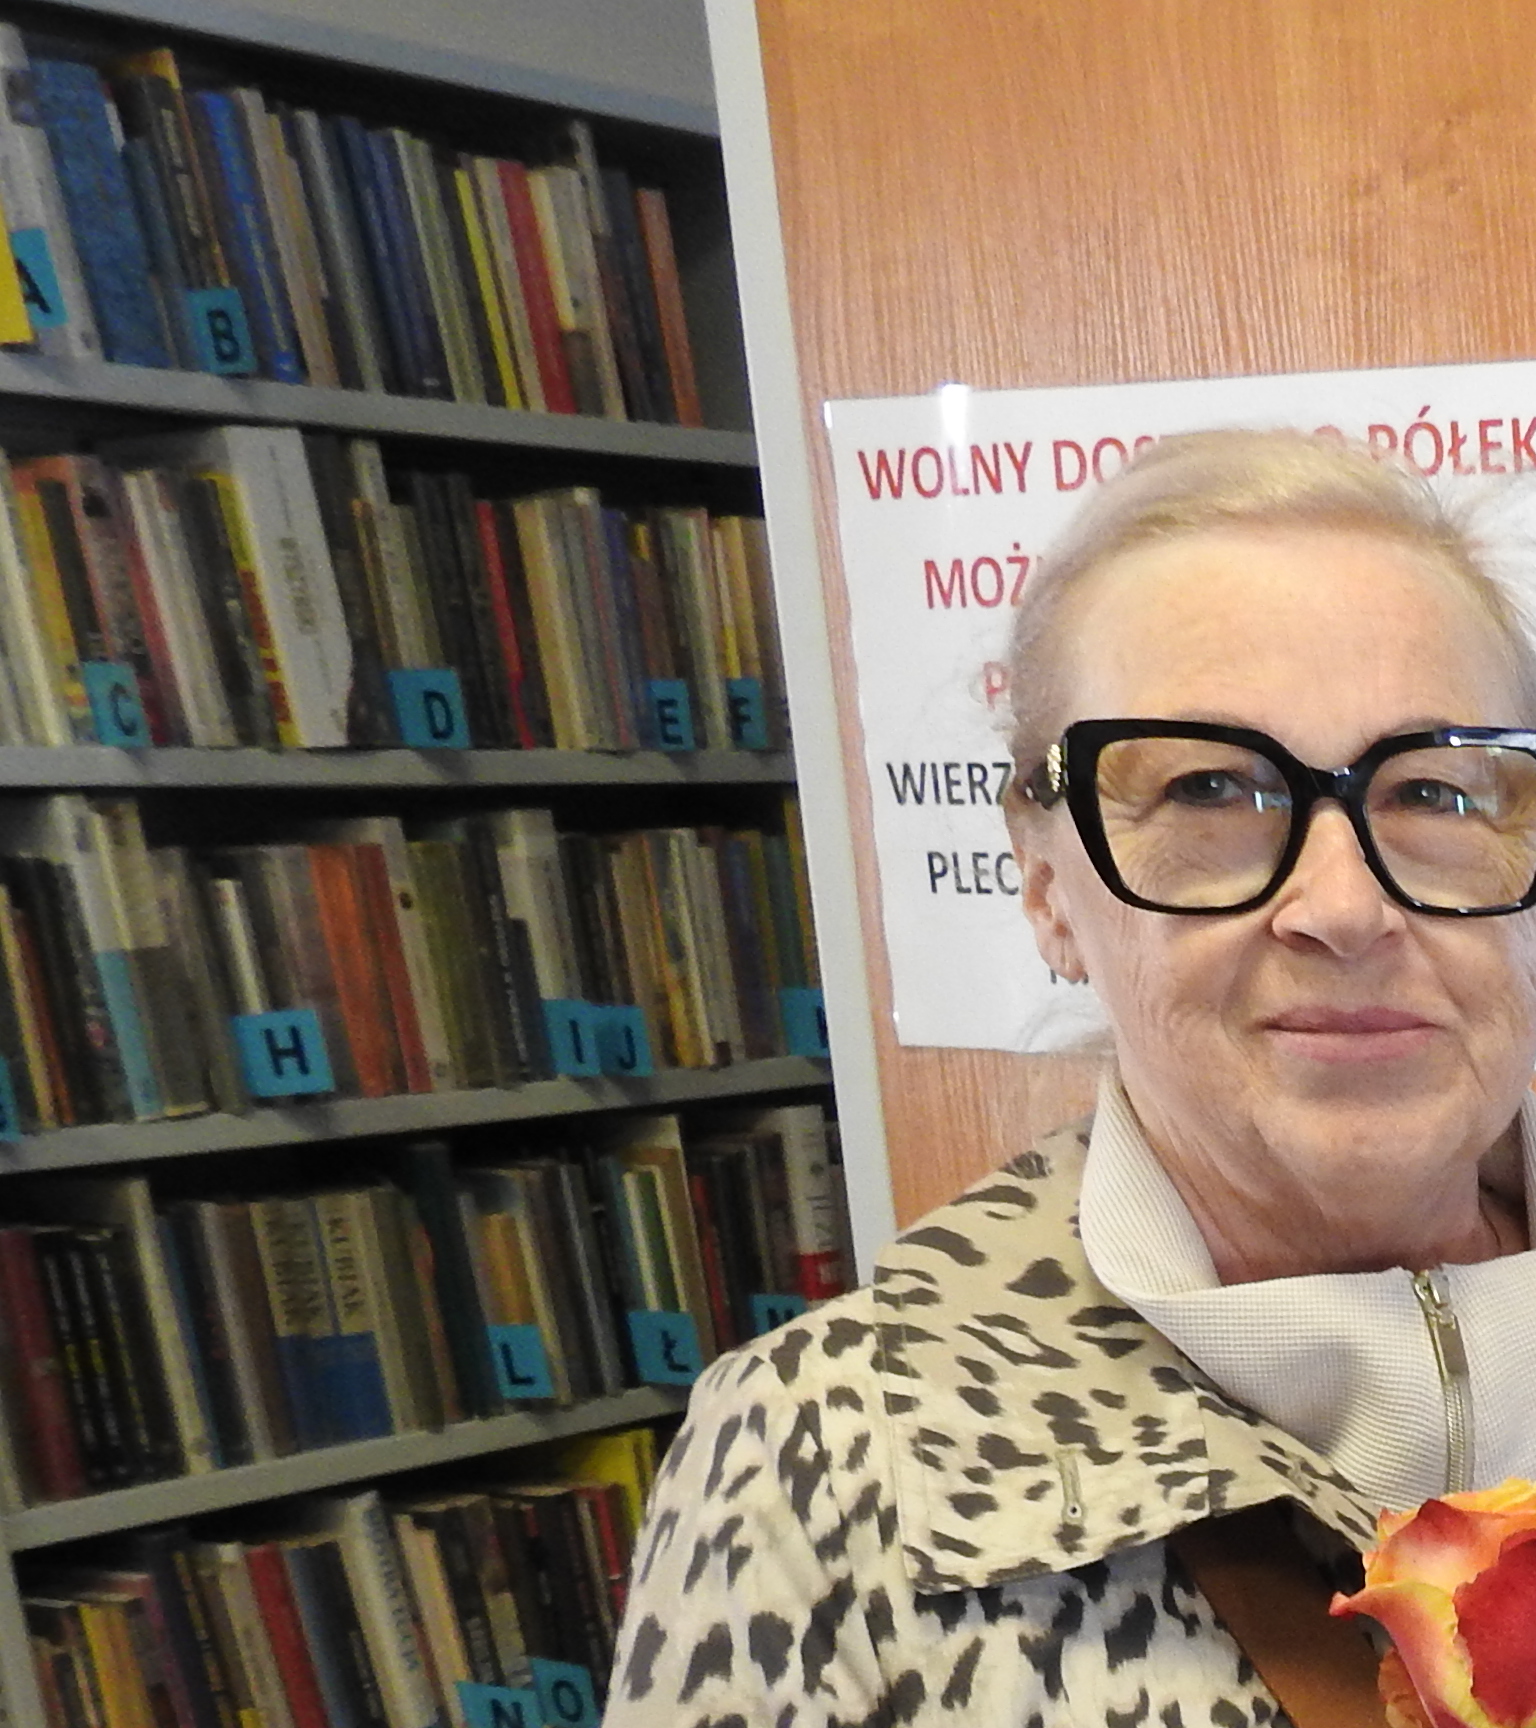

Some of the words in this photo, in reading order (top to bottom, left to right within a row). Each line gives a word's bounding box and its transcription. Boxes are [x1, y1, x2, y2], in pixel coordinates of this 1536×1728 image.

[209, 308, 239, 363] B
[857, 440, 1032, 500] WOLNY
[923, 541, 1043, 610] MOŻ
[111, 683, 141, 735] C
[424, 690, 456, 739] D
[658, 698, 683, 745] E
[731, 696, 752, 743] F
[263, 1025, 312, 1077] H
[616, 1025, 640, 1070] J
[498, 1342, 535, 1386] L
[550, 1677, 585, 1723] O
